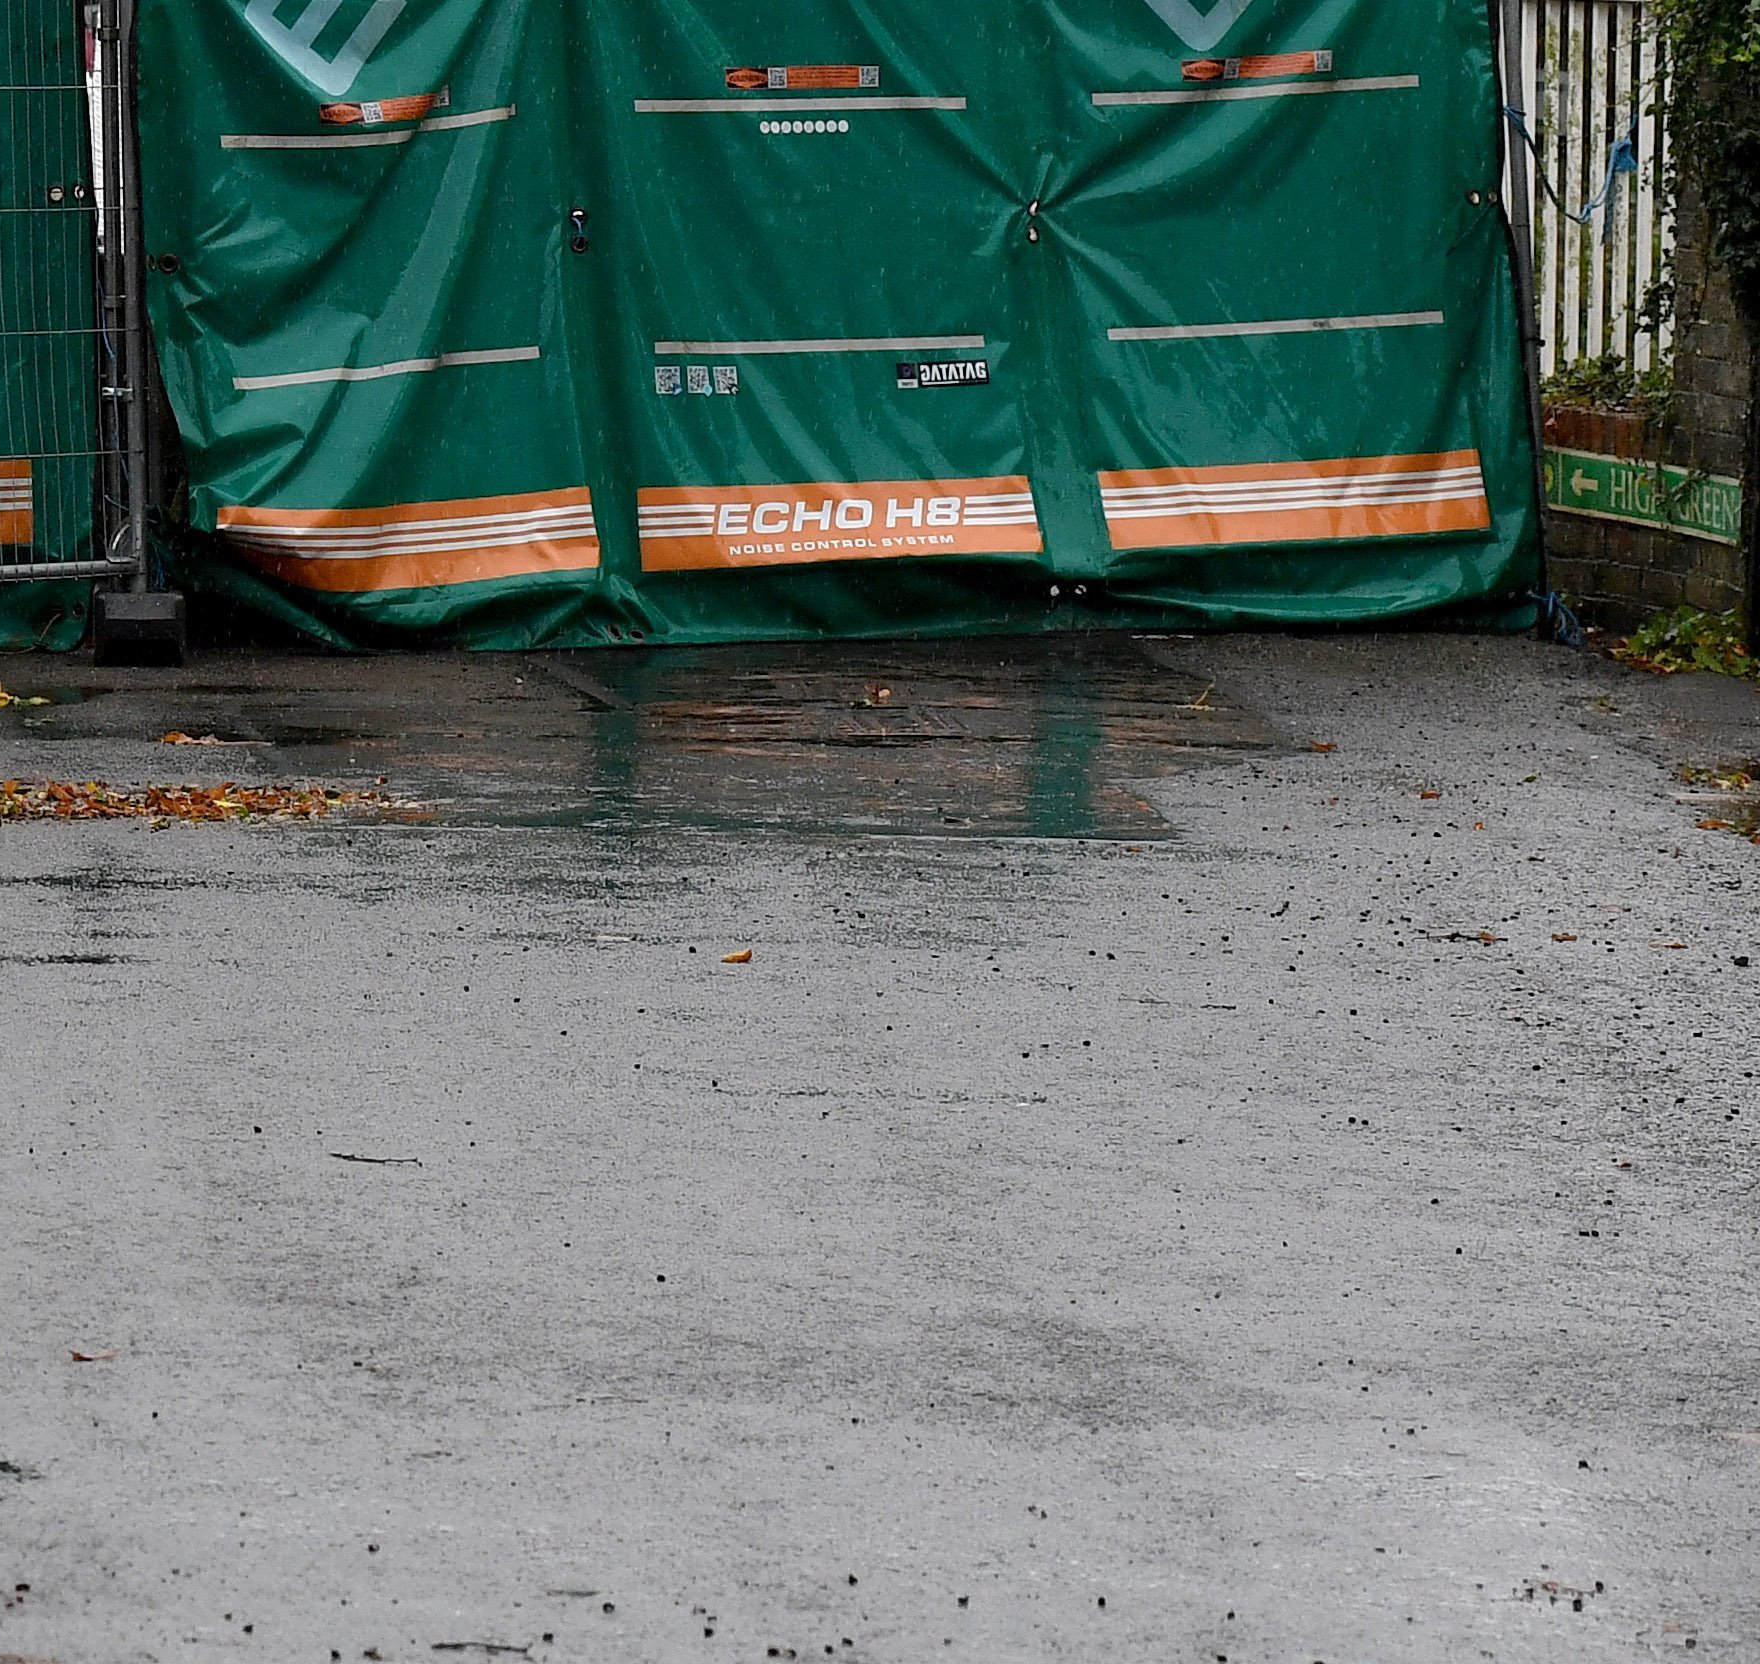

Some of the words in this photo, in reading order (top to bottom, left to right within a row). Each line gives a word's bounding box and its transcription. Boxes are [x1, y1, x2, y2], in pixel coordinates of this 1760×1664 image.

[716, 499, 873, 535] ECHO
[885, 496, 960, 528] H8
[728, 543, 785, 556] NOISE
[791, 538, 877, 553] CONTROL
[882, 534, 955, 548] SYSTEM
